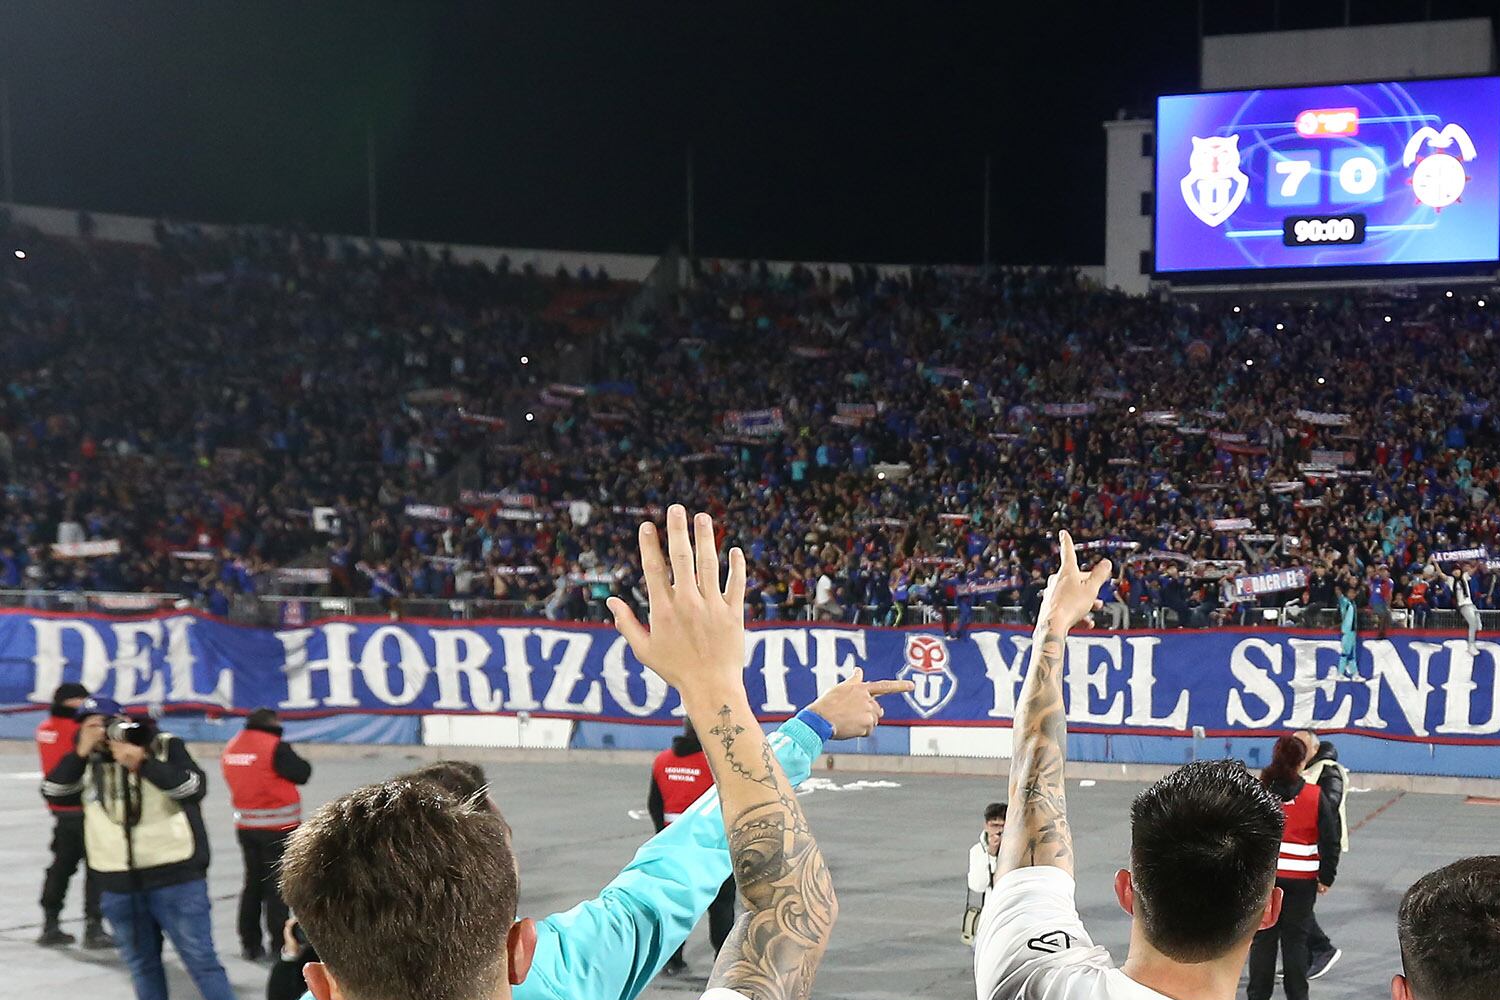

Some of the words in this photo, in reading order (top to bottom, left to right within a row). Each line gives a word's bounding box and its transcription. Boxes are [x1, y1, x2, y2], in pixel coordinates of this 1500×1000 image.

[1275, 160, 1311, 197] 7
[1339, 157, 1378, 194] 0
[1293, 218, 1356, 243] 90:00
[27, 615, 235, 710] DEL
[274, 624, 867, 717] HORIZOTE
[970, 631, 1033, 719] Y
[1065, 635, 1190, 730] EL
